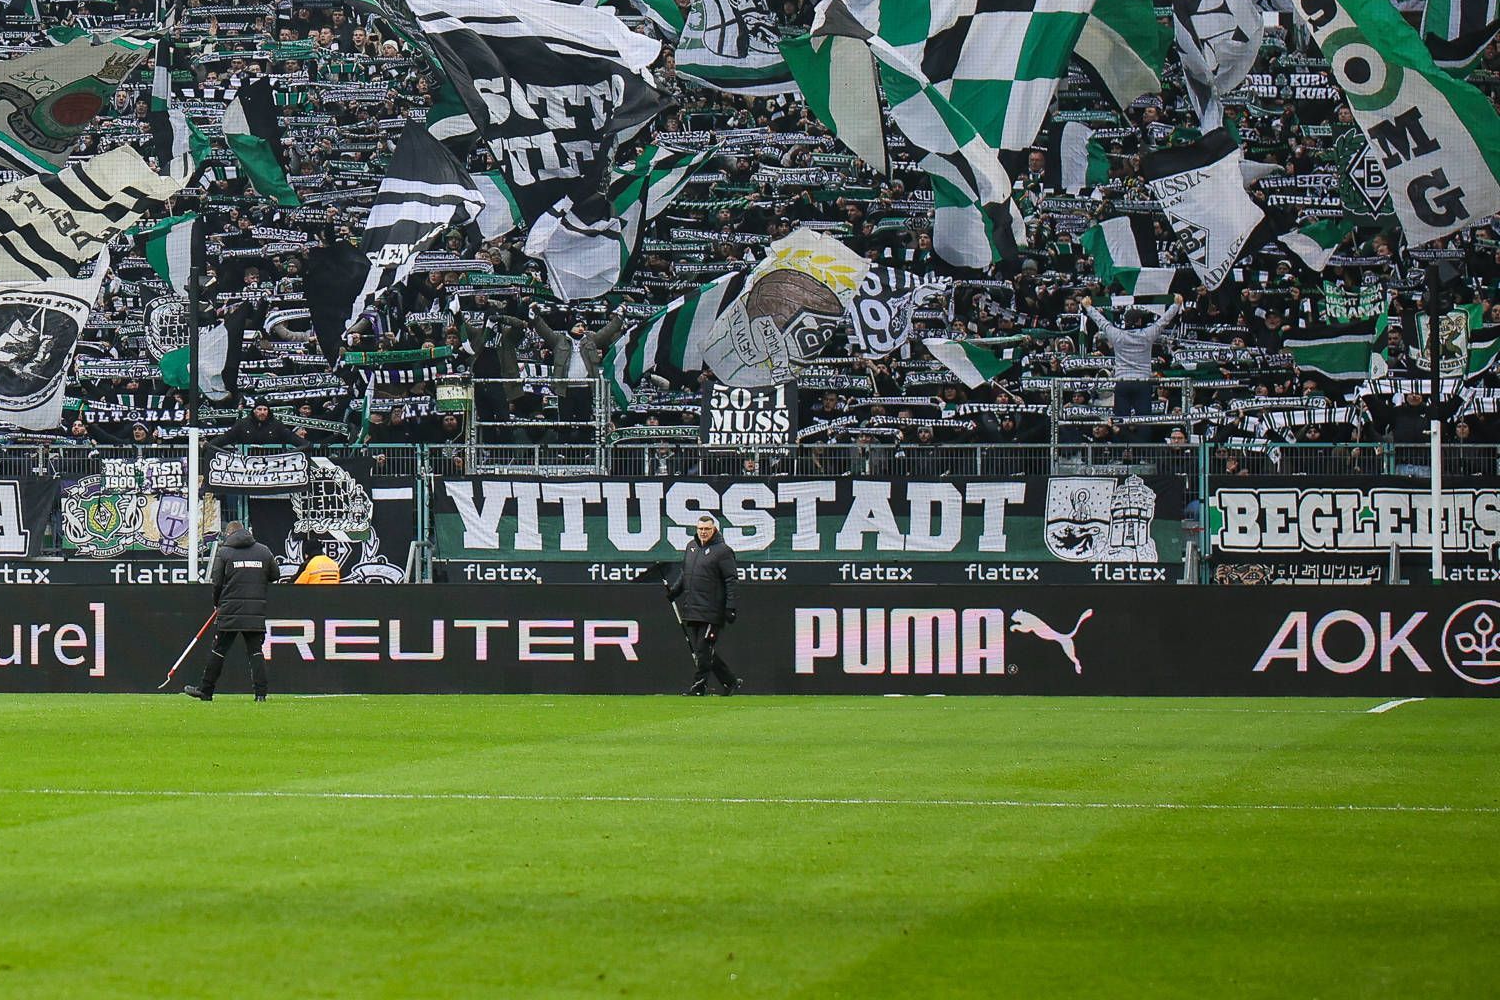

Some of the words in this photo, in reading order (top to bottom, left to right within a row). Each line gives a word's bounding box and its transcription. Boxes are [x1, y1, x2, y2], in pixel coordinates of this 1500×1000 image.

[710, 384, 788, 409] 50+1
[708, 410, 789, 431] MUSS
[709, 433, 789, 445] BLEIBEN!
[105, 463, 137, 477] BMG
[152, 462, 182, 476] TSR
[210, 452, 308, 472] JÄGER
[105, 476, 136, 489] 1900
[152, 475, 182, 488] 1921
[444, 480, 1025, 552] VITUSSTADT
[463, 563, 538, 583] flatex
[838, 564, 913, 581] flatex
[965, 564, 1040, 581] flatex
[1090, 564, 1166, 581] flatex
[264, 619, 640, 661] REUTER
[795, 608, 1005, 674] PUMA
[1252, 610, 1432, 672] AOK
